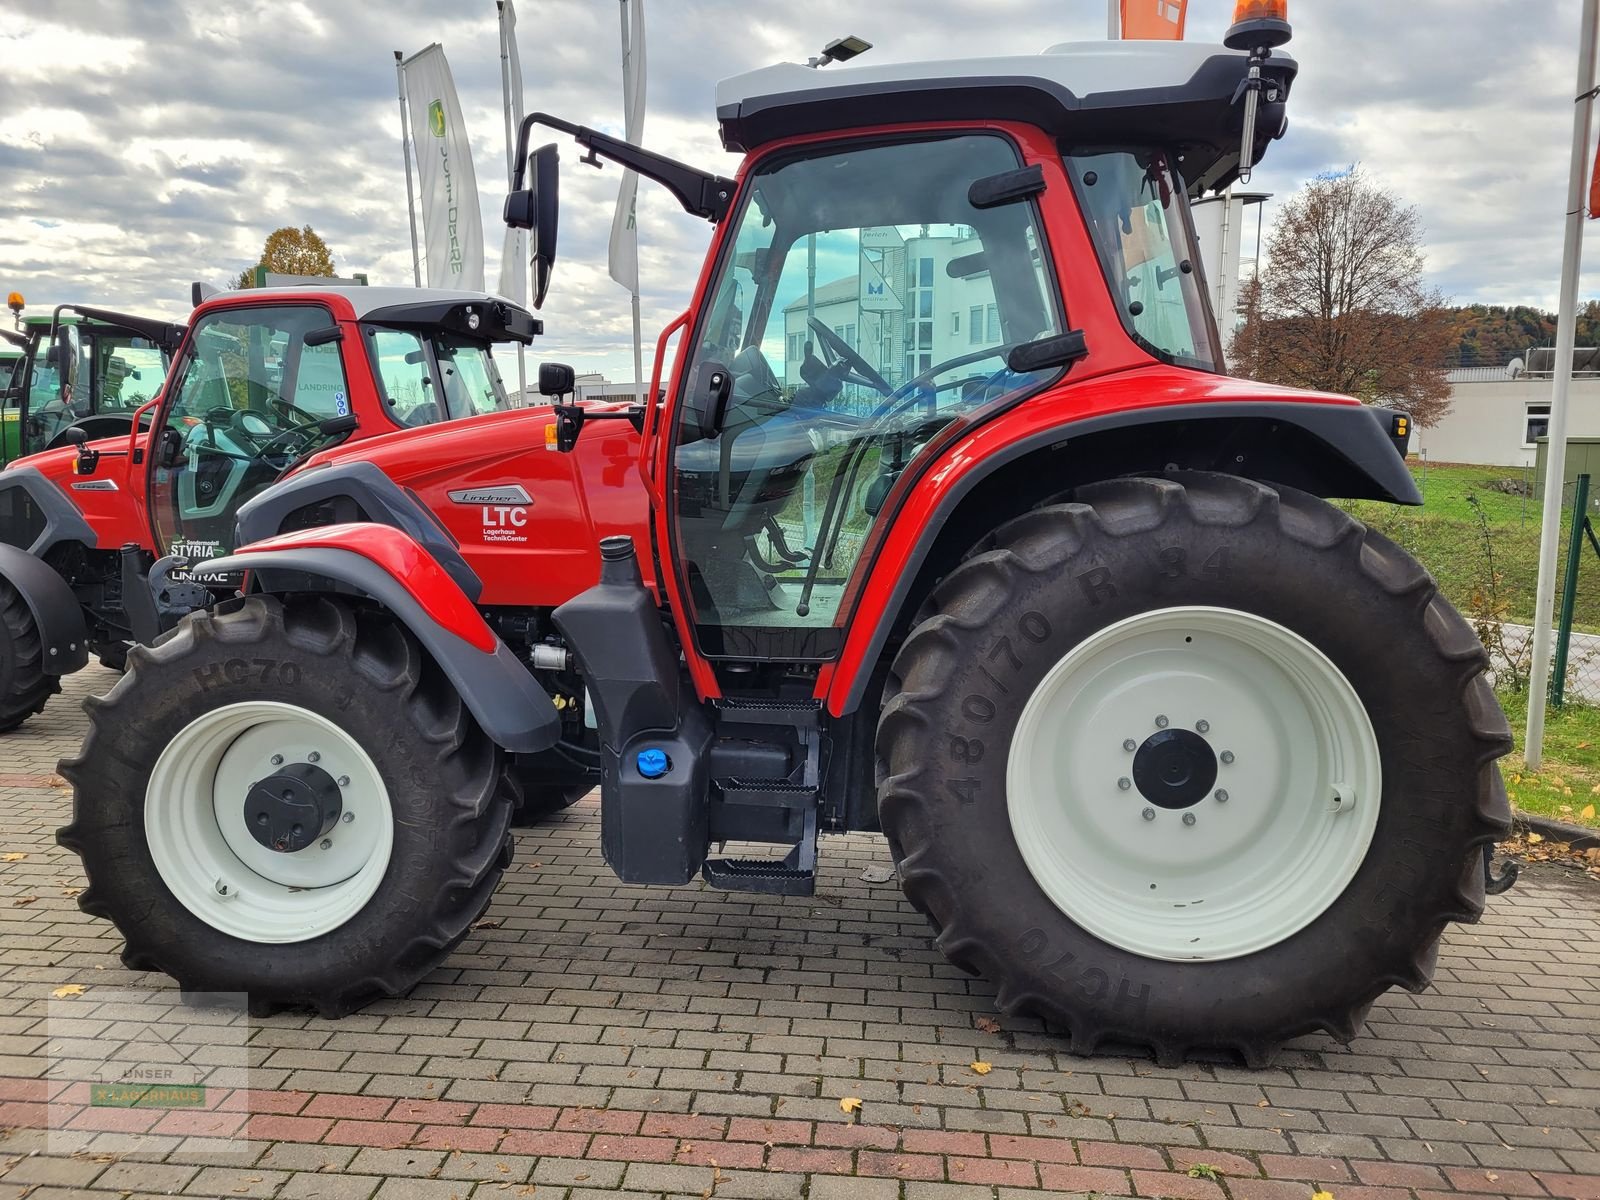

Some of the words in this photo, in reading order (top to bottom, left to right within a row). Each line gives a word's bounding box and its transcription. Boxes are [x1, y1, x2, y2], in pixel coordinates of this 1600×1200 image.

[448, 206, 463, 275] DEERE
[462, 493, 517, 501] Lindner
[483, 506, 527, 527] LTC
[170, 544, 214, 557] STYRIA
[192, 658, 301, 692] HC70
[947, 610, 1052, 804] 480/70
[1075, 565, 1119, 605] R
[1159, 544, 1232, 583] 34
[1016, 926, 1151, 1016] HC70
